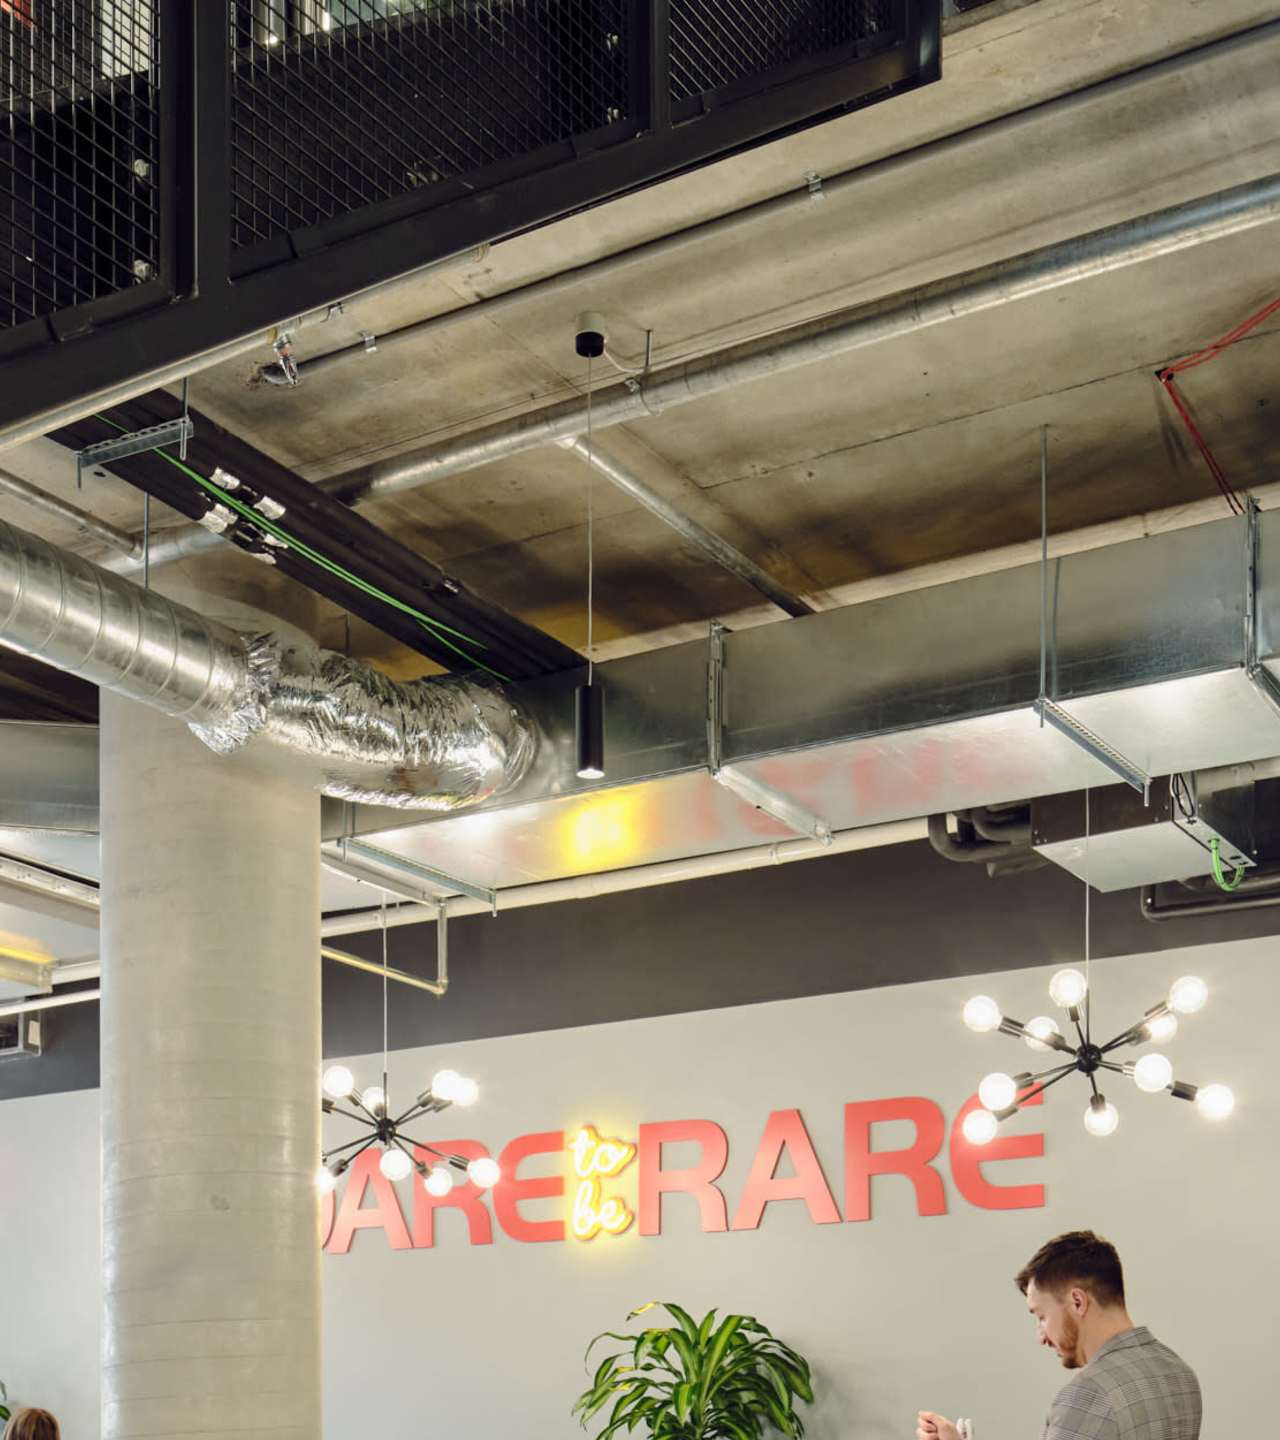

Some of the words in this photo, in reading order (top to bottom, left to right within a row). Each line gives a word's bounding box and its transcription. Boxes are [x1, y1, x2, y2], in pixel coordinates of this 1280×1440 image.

[319, 1130, 565, 1254] ARE
[568, 1126, 636, 1177] to
[638, 1082, 1046, 1237] RARE
[574, 1178, 633, 1239] be
